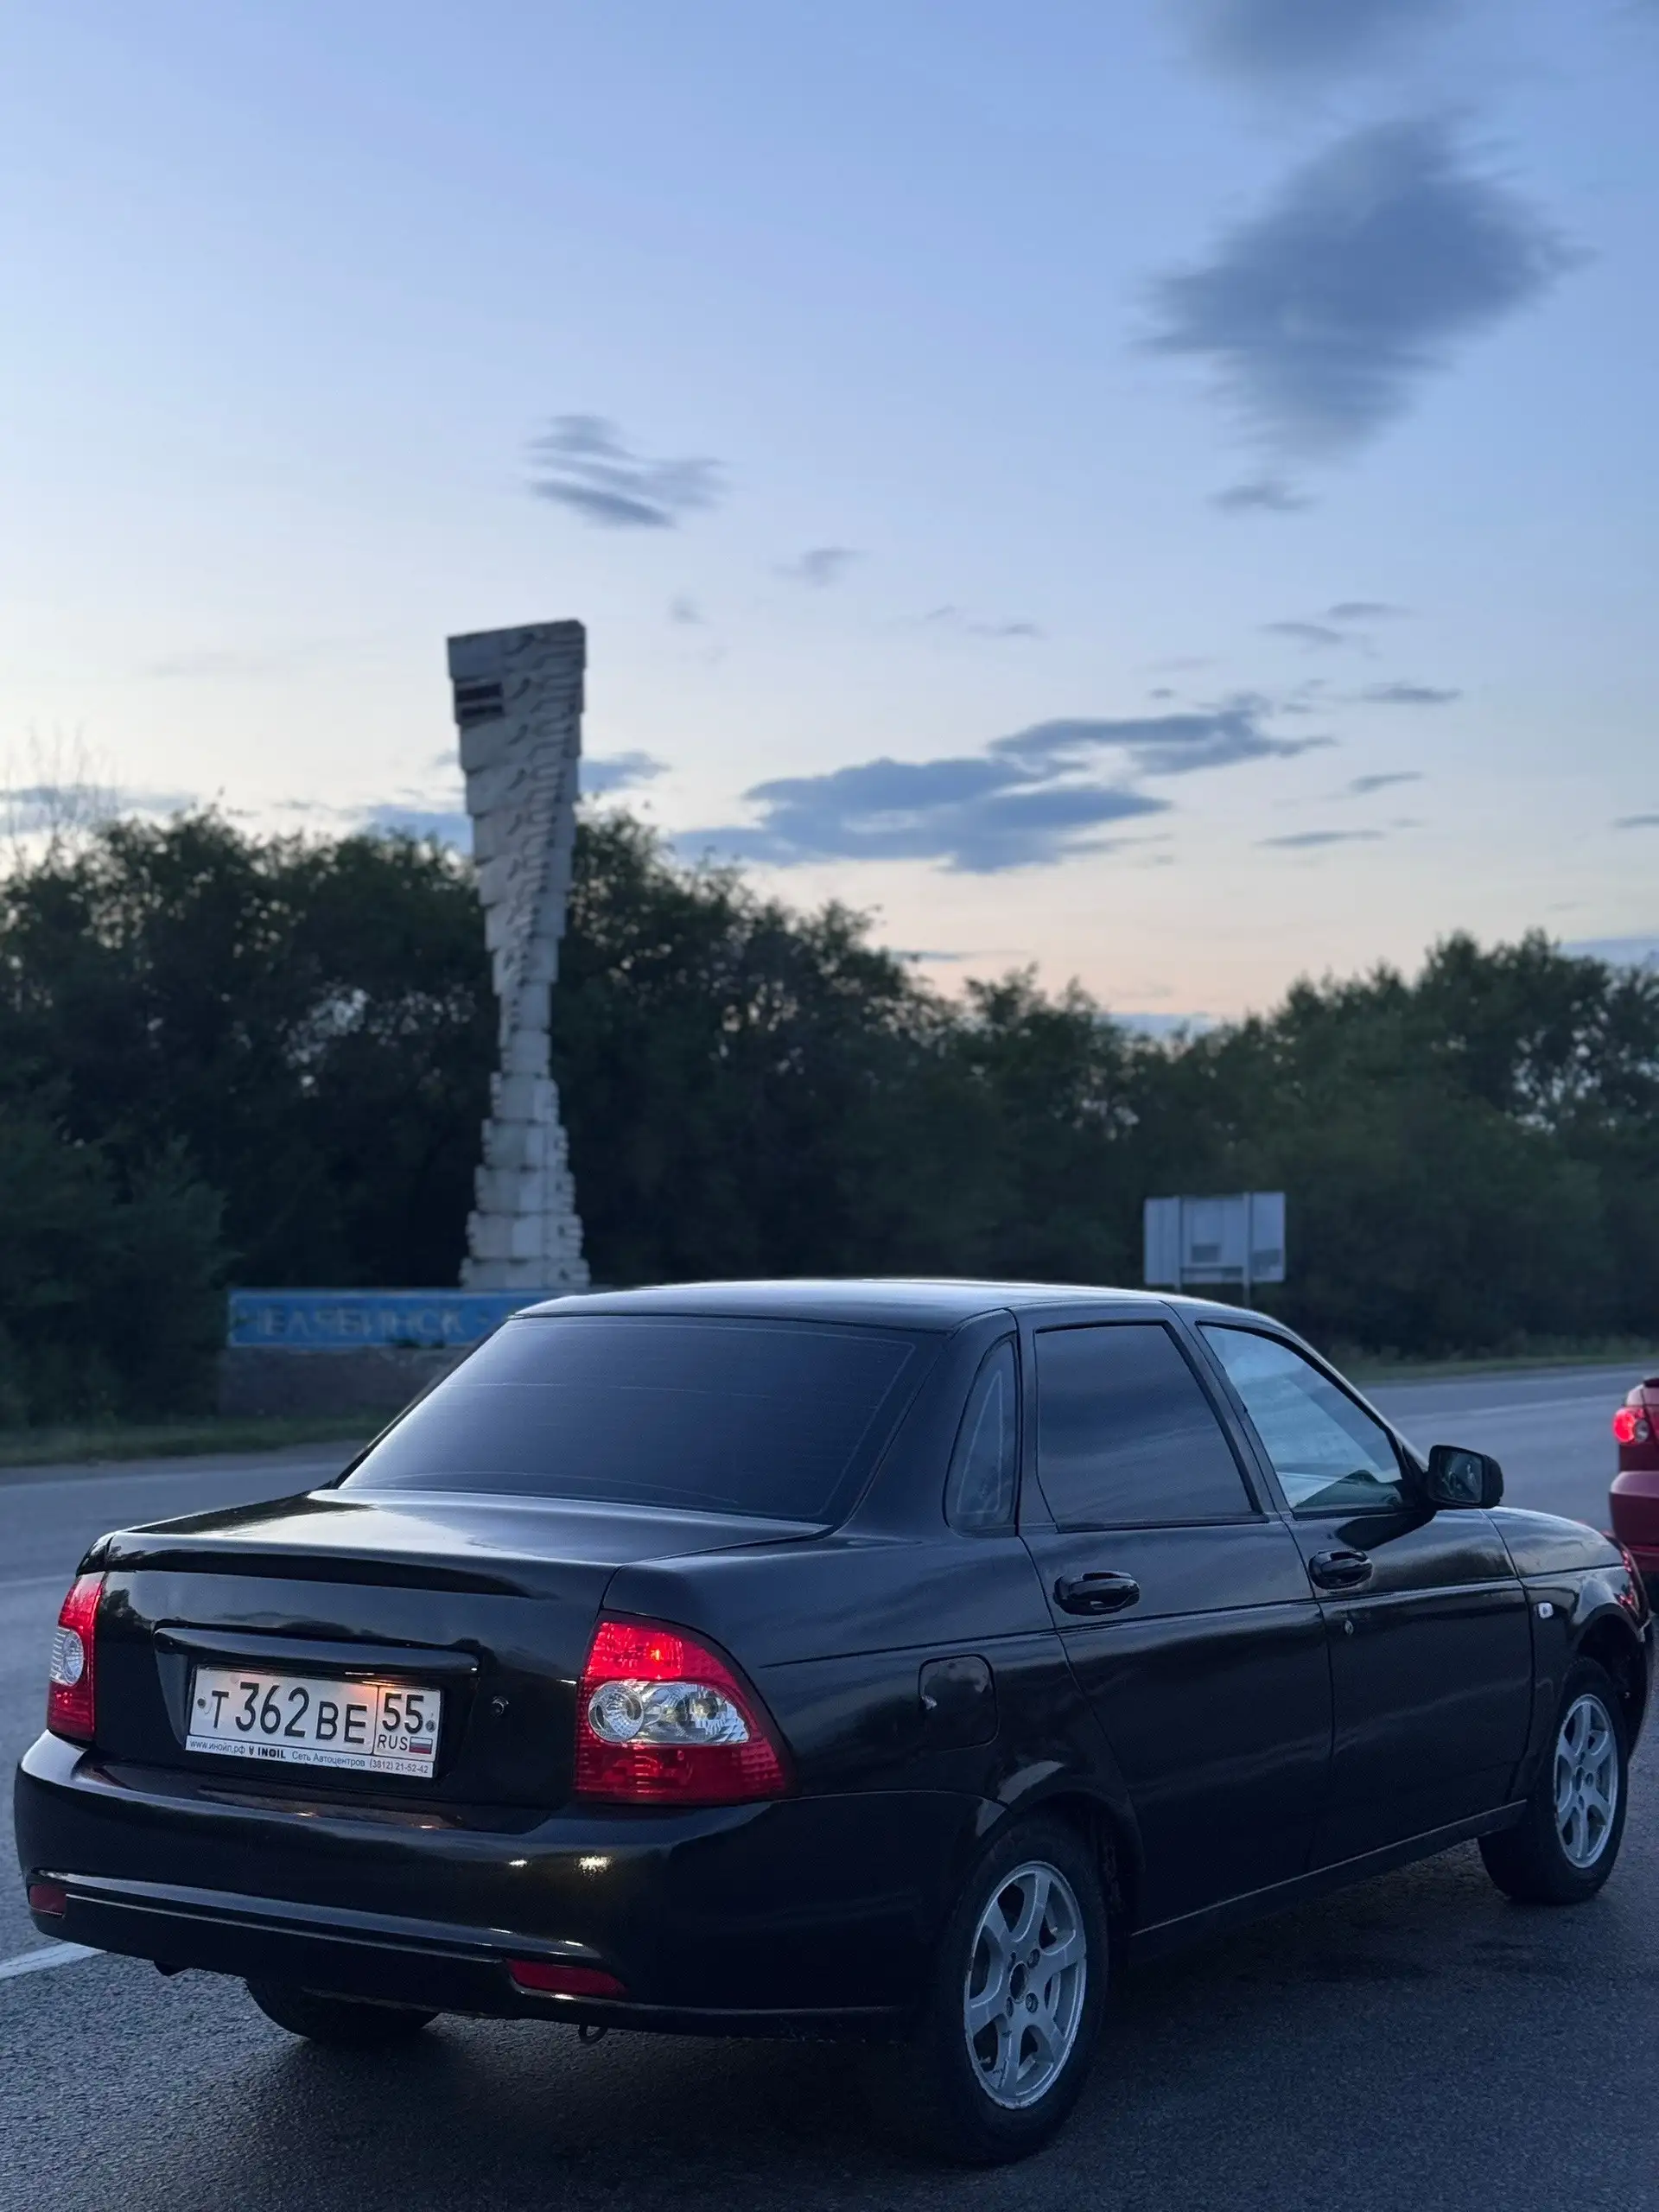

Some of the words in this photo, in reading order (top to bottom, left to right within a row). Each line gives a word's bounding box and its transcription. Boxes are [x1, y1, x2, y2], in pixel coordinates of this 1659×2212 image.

[382, 1692, 424, 1734] 55
[377, 1734, 408, 1751] RUS
[257, 1747, 286, 1759] INOIL
[292, 1751, 311, 1762] Сеть
[313, 1753, 365, 1768] Автоцентров
[369, 1761, 393, 1770] (3812)
[395, 1763, 429, 1774] 21-52-42
